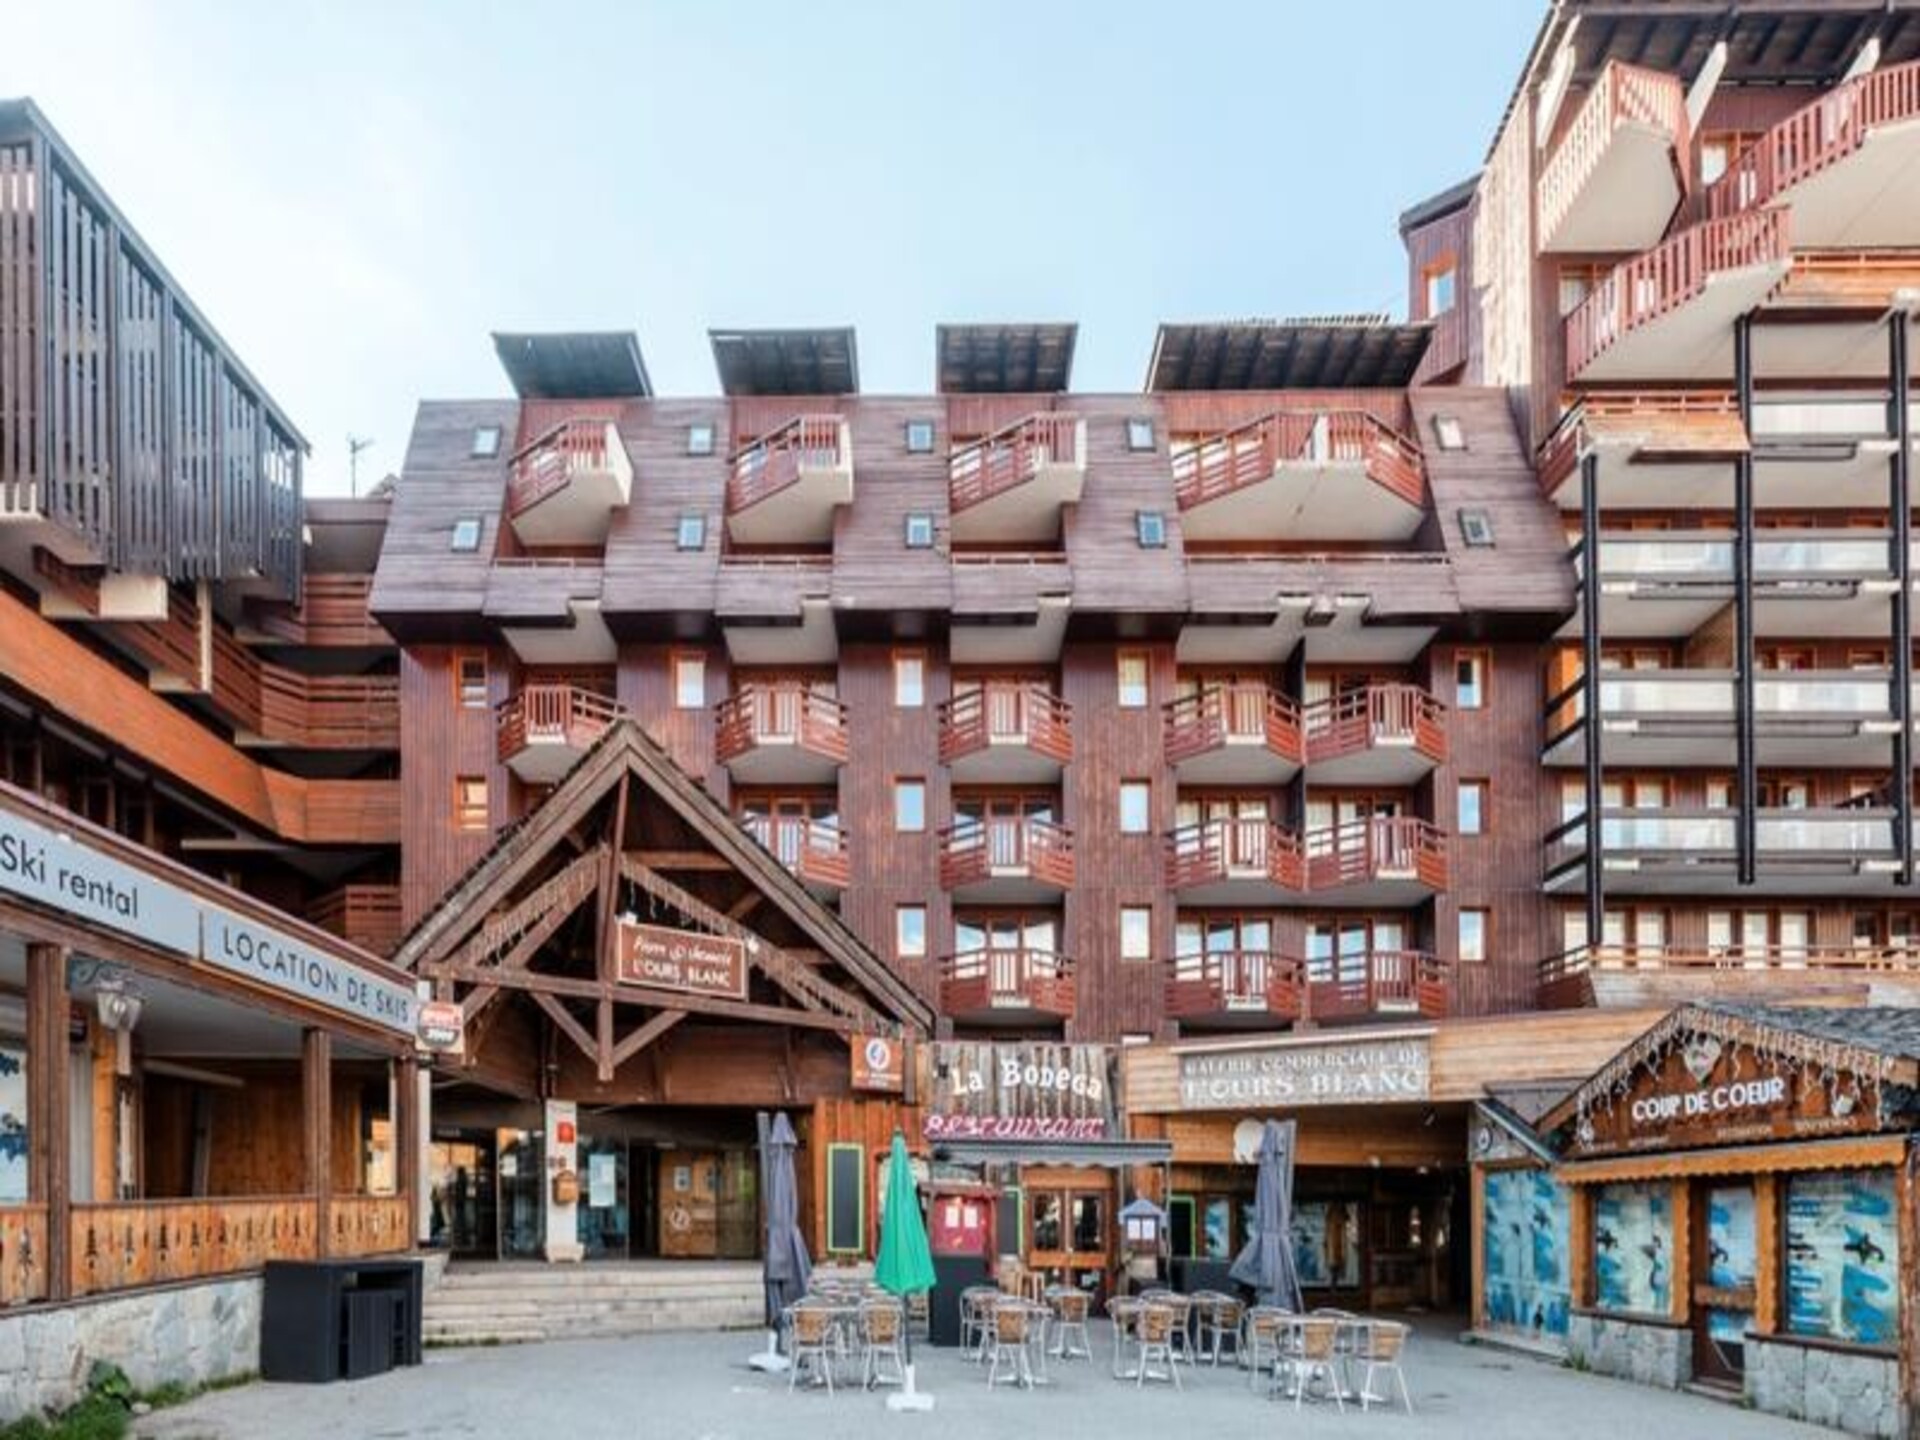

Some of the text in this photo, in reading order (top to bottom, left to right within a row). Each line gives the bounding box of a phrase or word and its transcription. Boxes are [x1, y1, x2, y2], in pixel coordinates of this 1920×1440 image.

[1, 834, 138, 919] Ski rental
[223, 926, 409, 1023] LOCATION DE SKIS
[1310, 1068, 1423, 1096] BLANC
[1632, 1076, 1786, 1122] COUP DE COEUR
